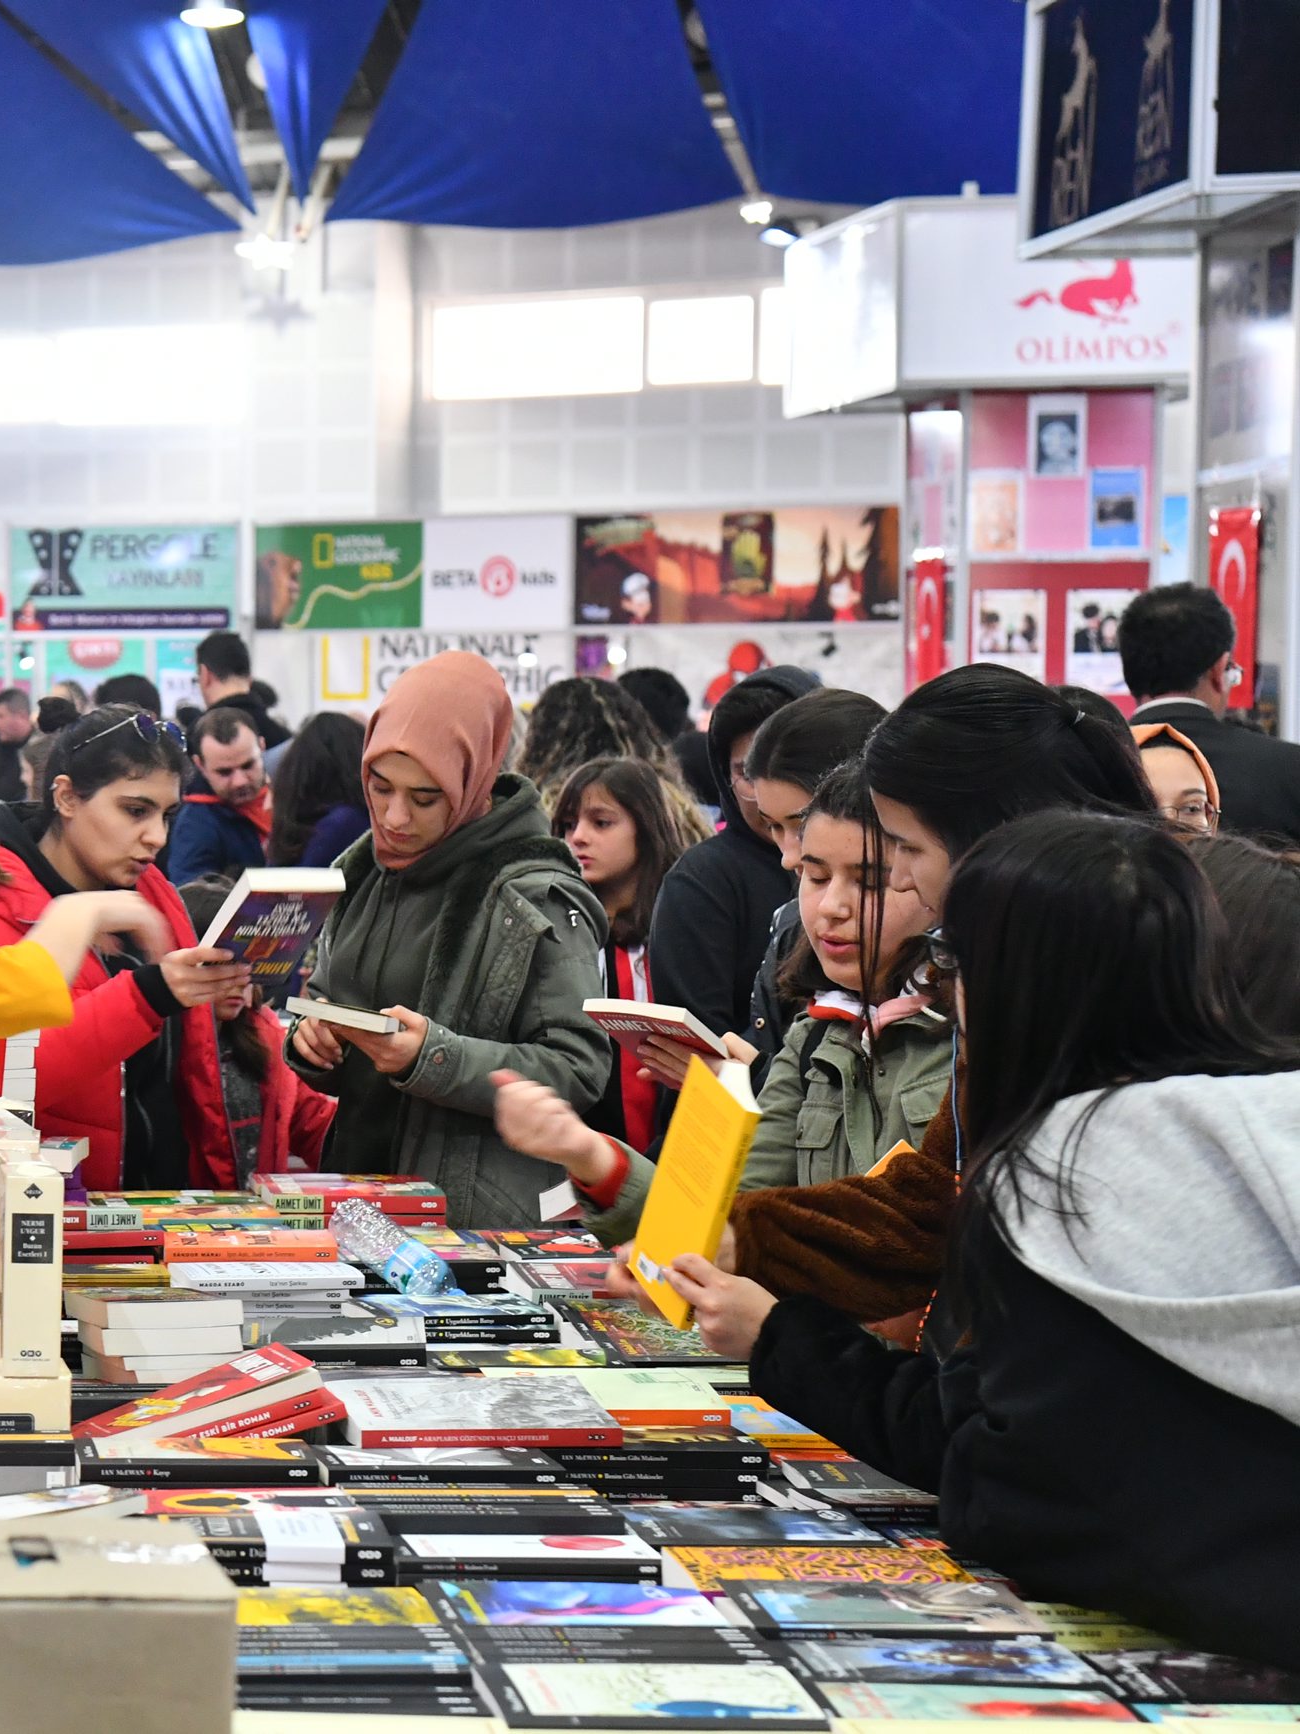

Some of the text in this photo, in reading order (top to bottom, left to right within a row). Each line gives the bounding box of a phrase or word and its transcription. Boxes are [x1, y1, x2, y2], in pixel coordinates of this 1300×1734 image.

[1016, 333, 1169, 365] OLİMPOS
[431, 570, 477, 586] BETA
[252, 961, 294, 975] AHME
[598, 1018, 654, 1032] AHMET
[276, 1198, 300, 1209] AHMET
[303, 1196, 321, 1209] ÜMİT
[89, 1213, 109, 1228] ÜMİT
[111, 1213, 137, 1226] AHMET
[199, 1412, 271, 1438] ESKİ BİR ROMAN
[262, 1423, 295, 1438] ROMAN
